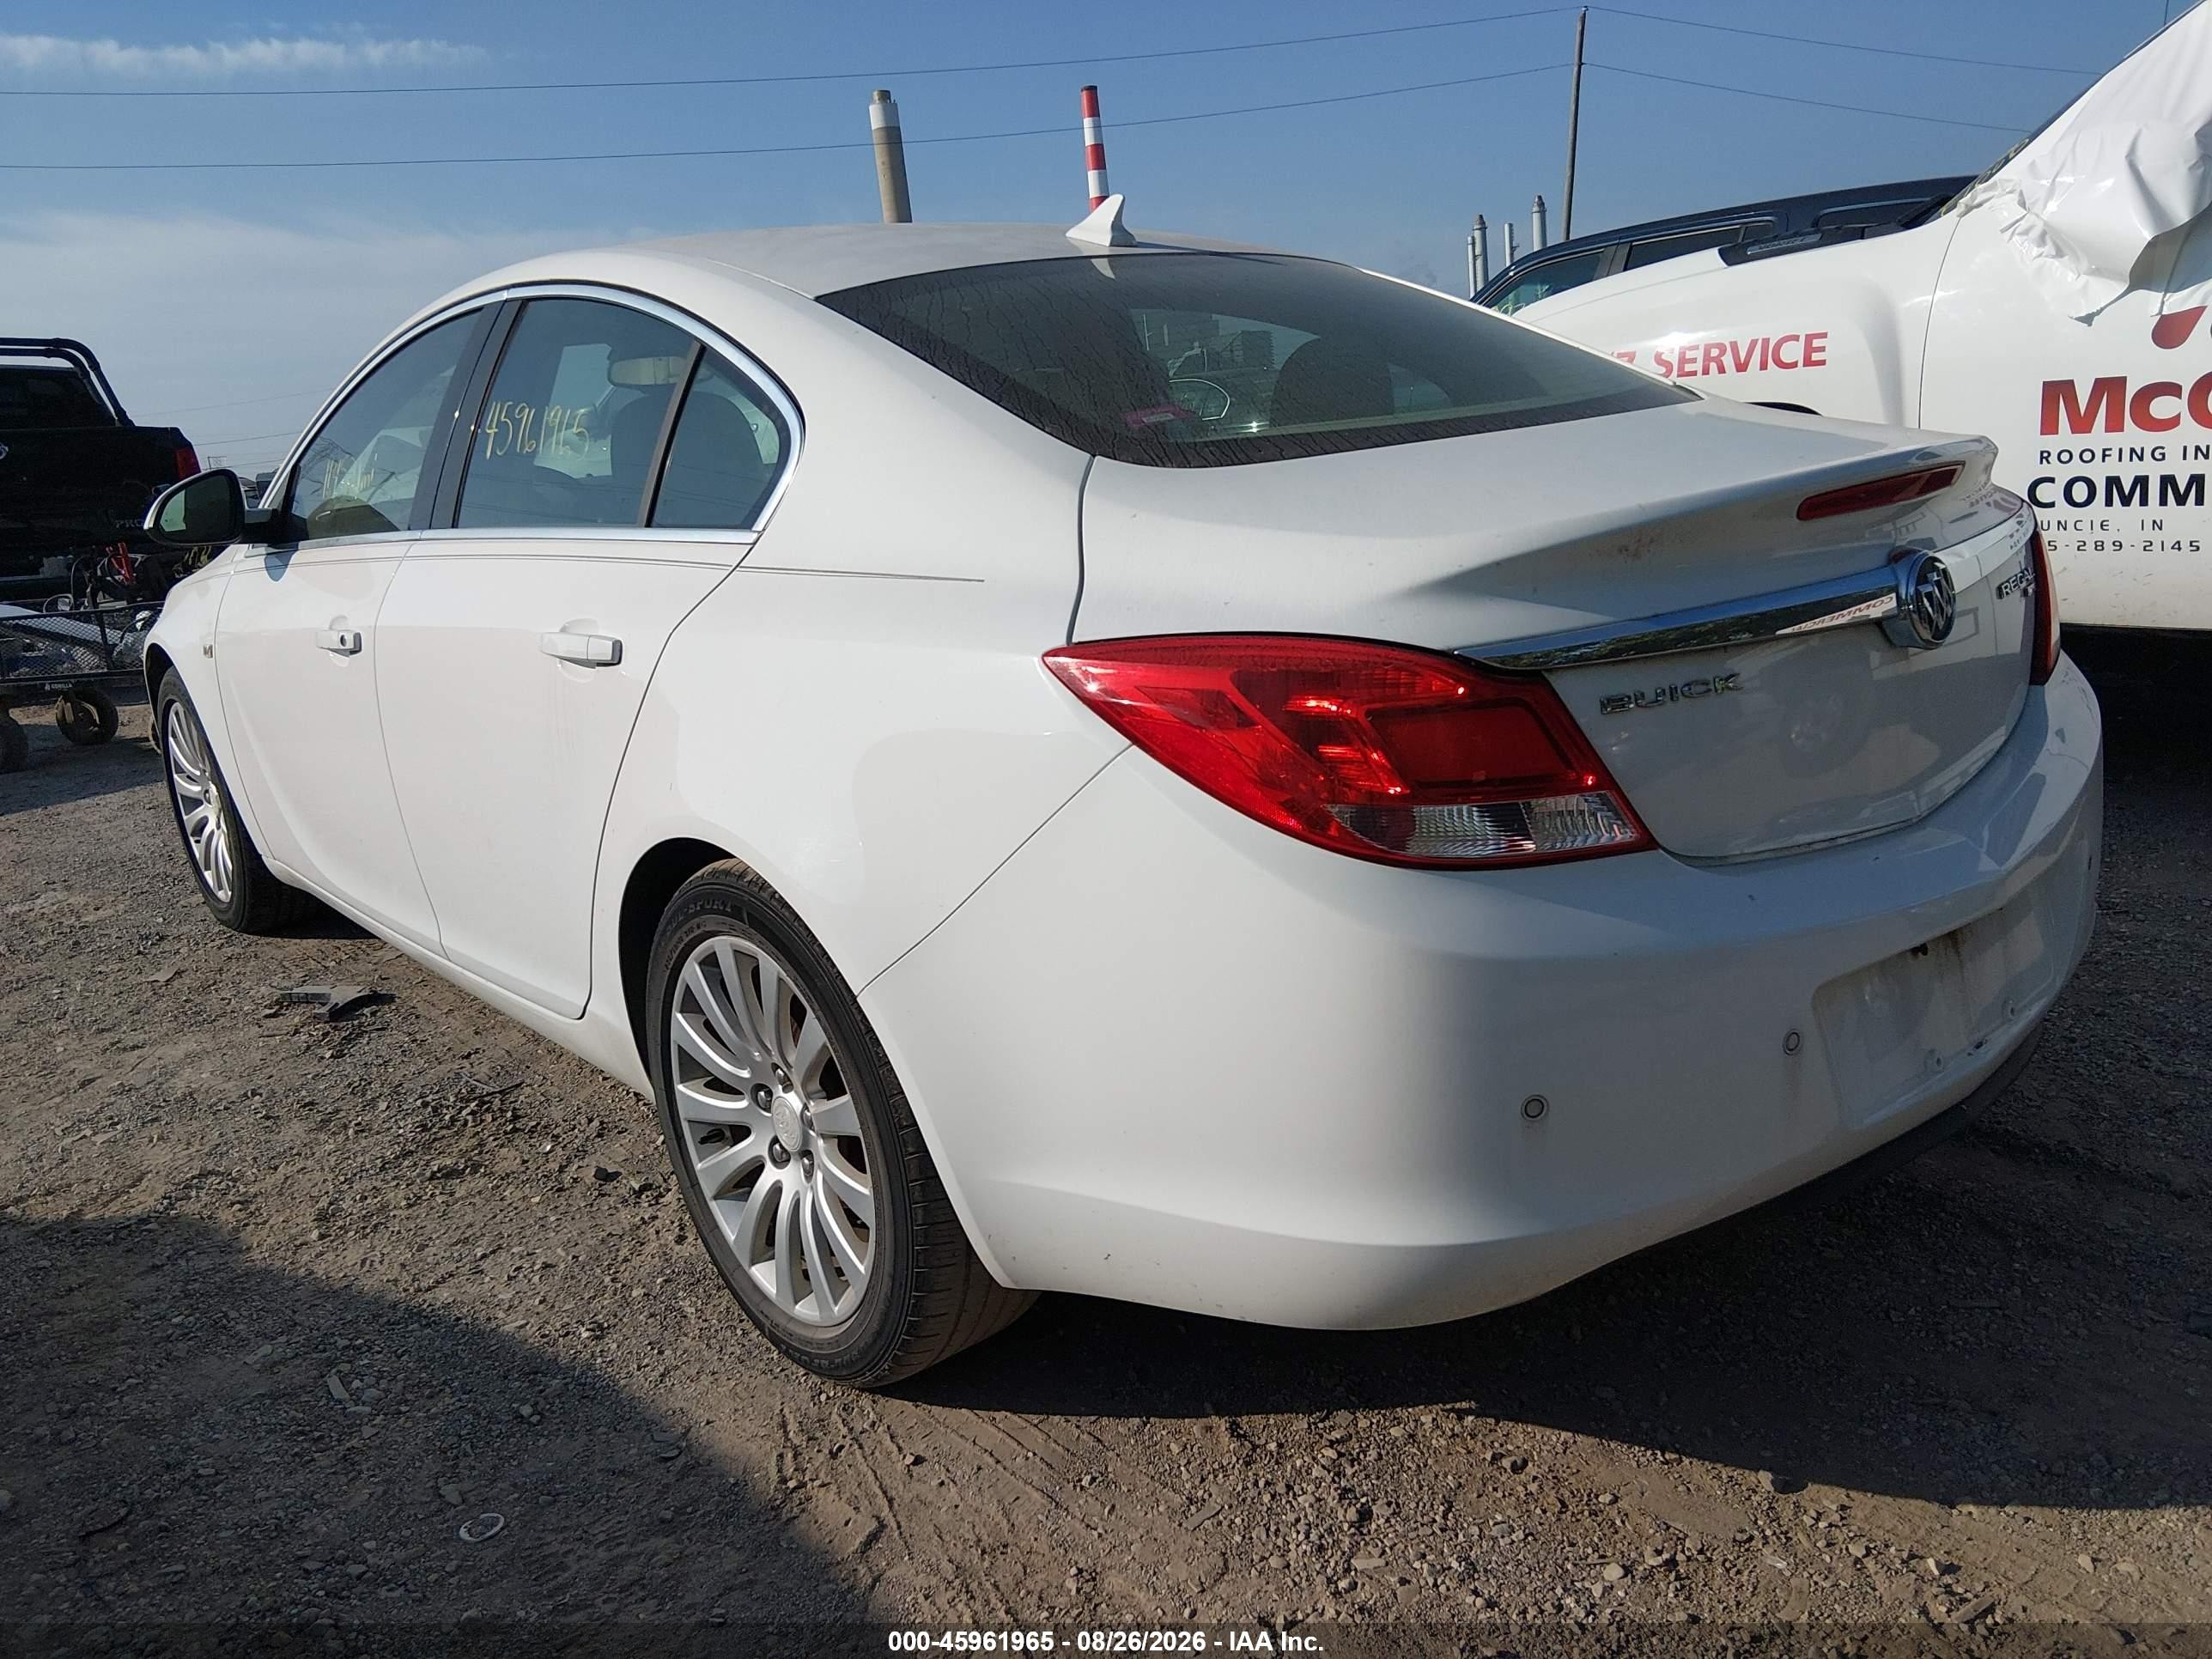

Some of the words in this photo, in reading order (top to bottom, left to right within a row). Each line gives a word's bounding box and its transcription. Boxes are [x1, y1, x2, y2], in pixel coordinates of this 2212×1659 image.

[1653, 331, 1829, 379] SERVICE
[2039, 446, 2166, 465] ROOFING
[2027, 473, 2206, 508] COMM
[2141, 520, 2163, 531] IN
[2048, 539, 2201, 552] 5-289-2145
[1999, 568, 2037, 599] REGAL
[1600, 673, 1743, 714] BUICK
